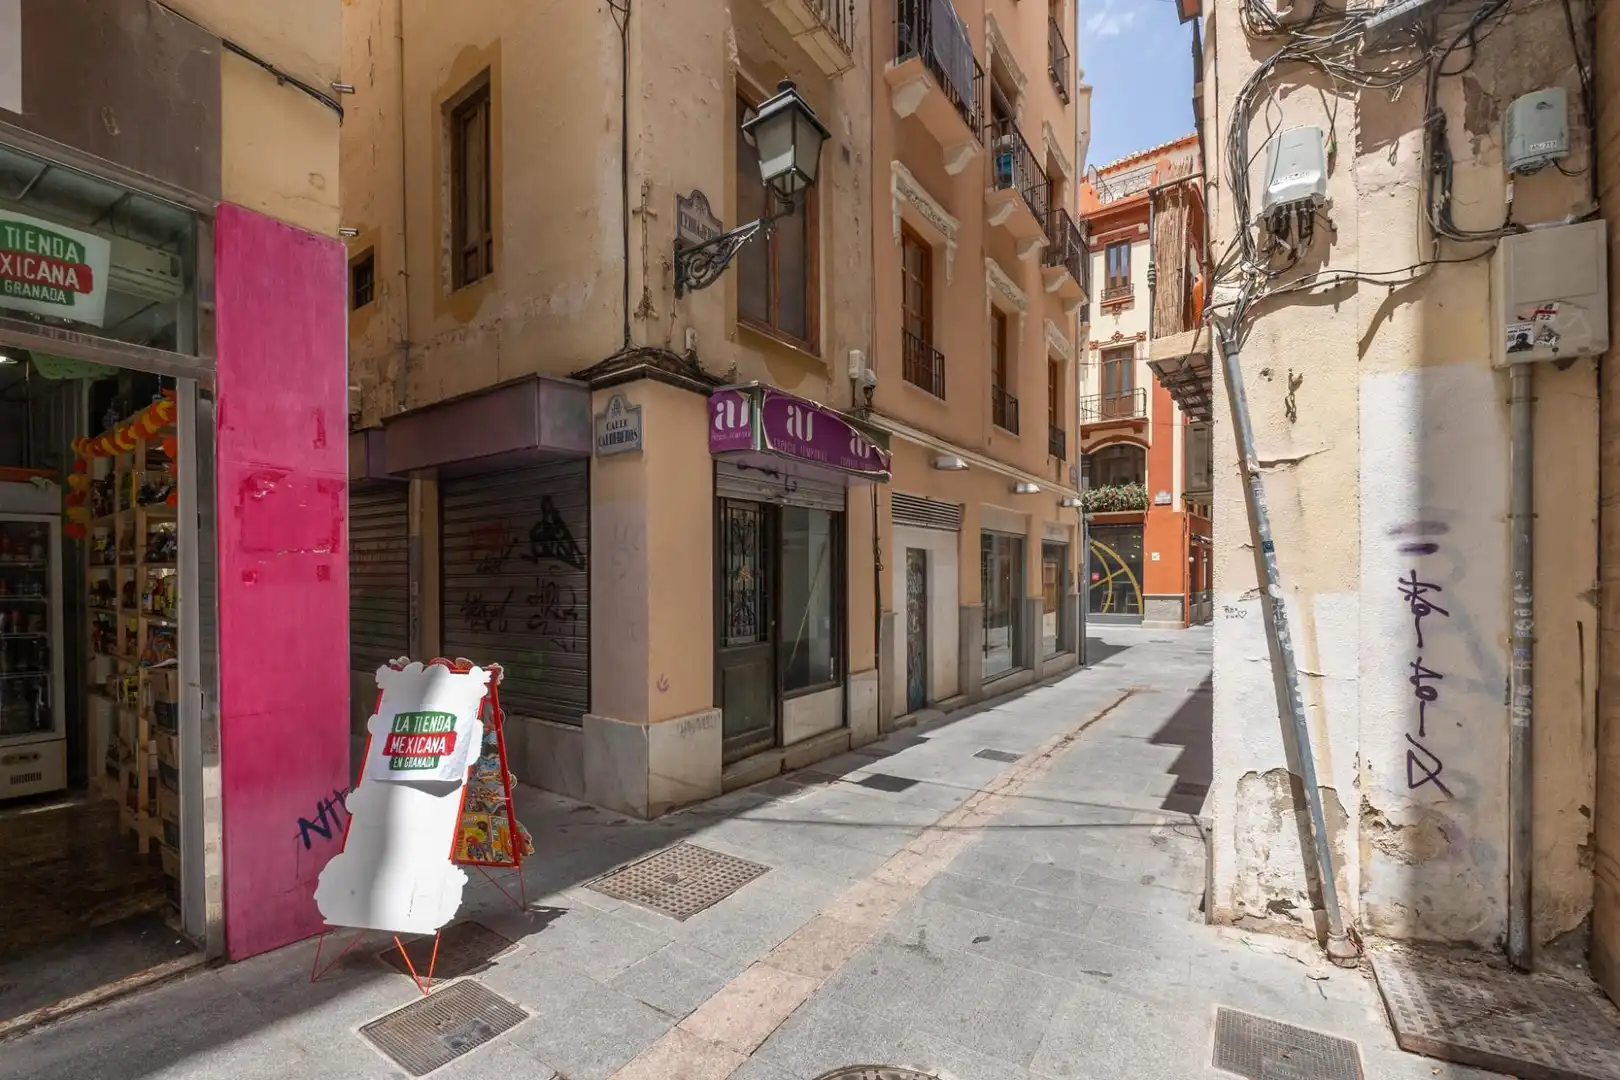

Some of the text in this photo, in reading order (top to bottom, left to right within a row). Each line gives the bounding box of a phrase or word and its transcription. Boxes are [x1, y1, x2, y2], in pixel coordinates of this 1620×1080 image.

[4, 225, 80, 264] TIENDA
[4, 279, 67, 304] GRANADA
[395, 715, 452, 733] LA TIENDA
[389, 736, 446, 754] MEXICANA
[393, 756, 434, 768] EN GRANADA
